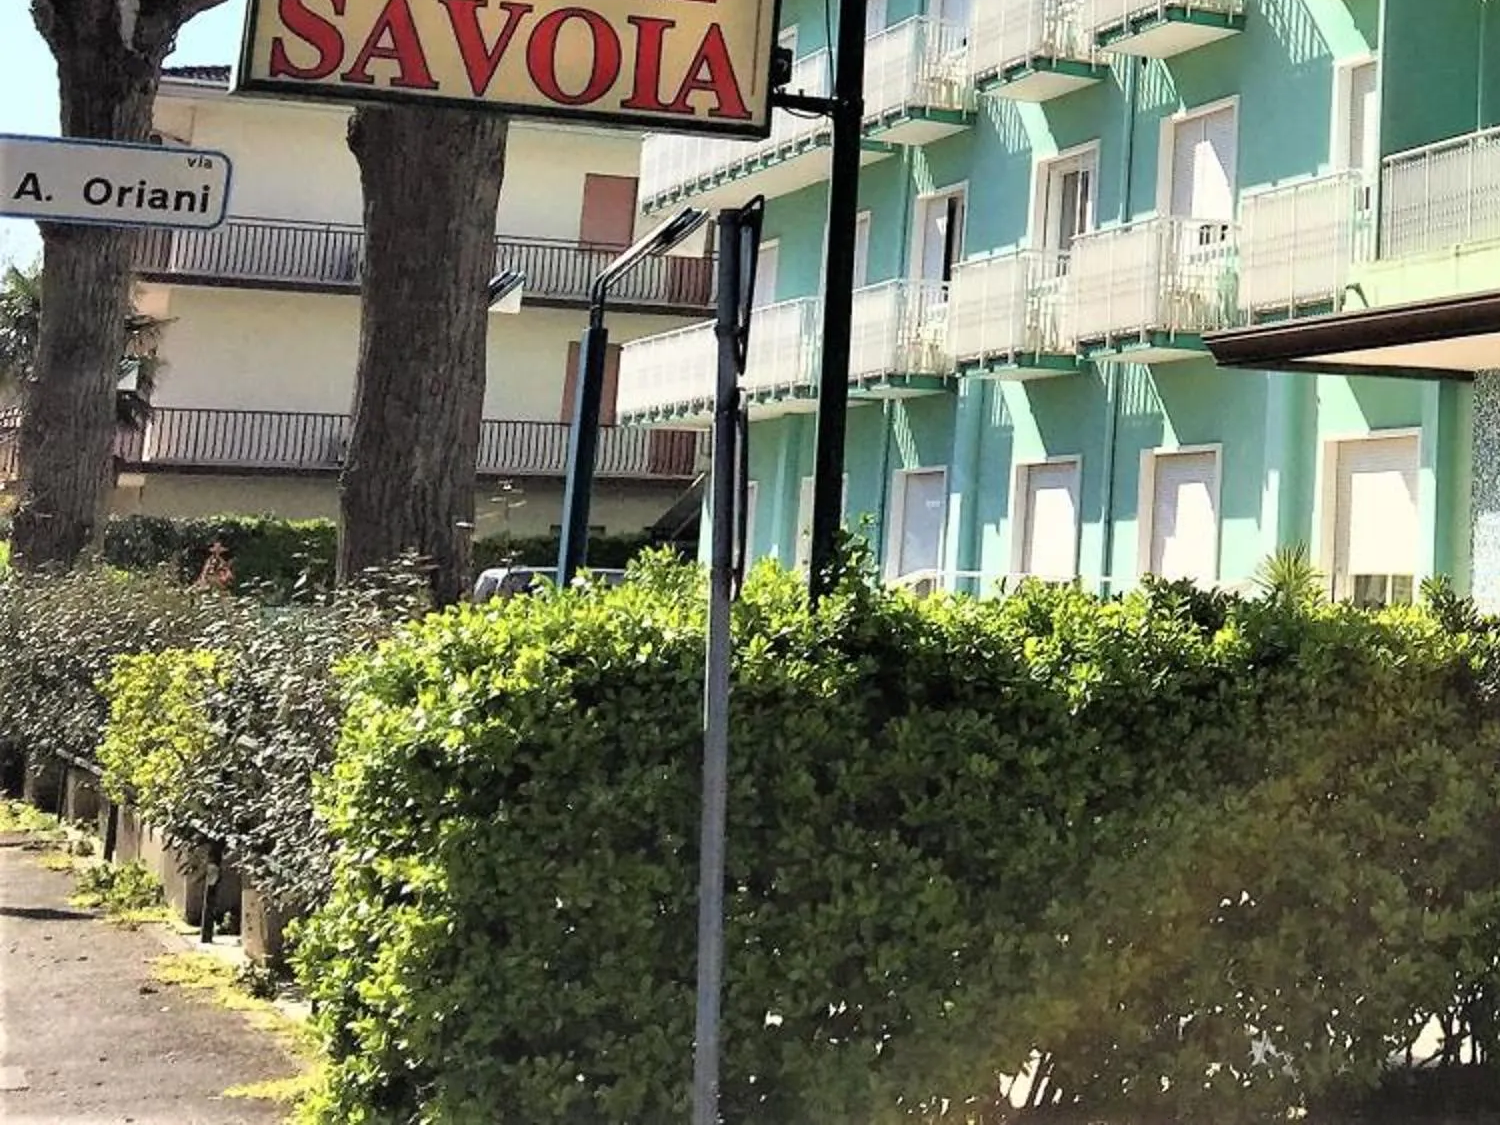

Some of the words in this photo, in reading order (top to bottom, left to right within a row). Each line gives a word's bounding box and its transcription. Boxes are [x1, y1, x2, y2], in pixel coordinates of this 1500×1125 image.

[187, 155, 212, 169] via
[13, 173, 53, 201] A.
[83, 177, 211, 213] Oriani
